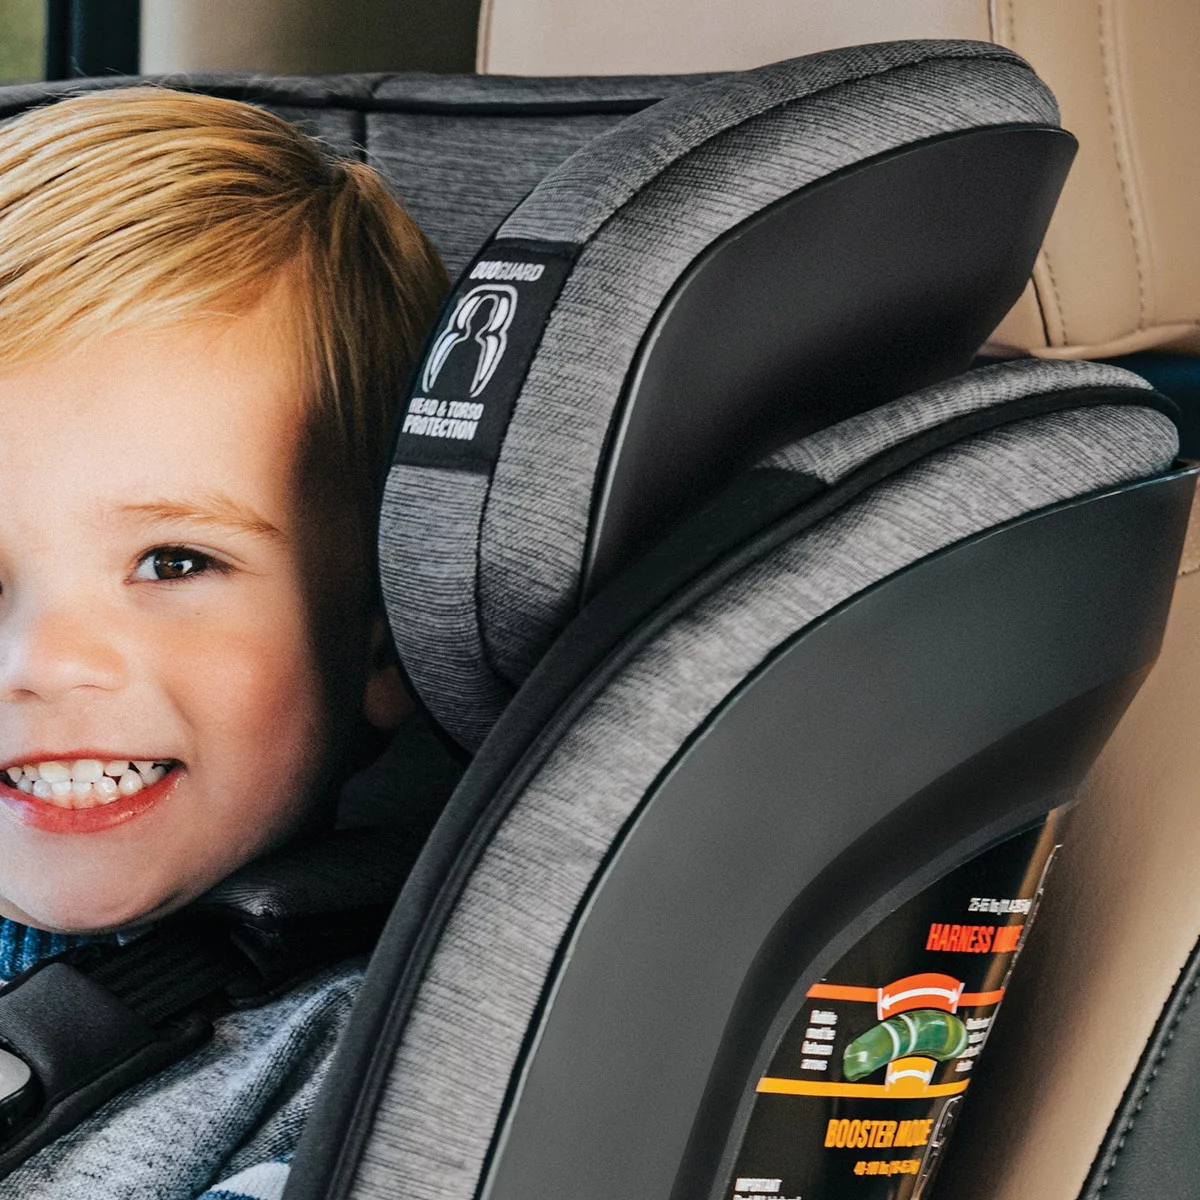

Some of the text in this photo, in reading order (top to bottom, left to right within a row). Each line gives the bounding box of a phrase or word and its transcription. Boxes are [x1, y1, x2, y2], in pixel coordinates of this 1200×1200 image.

[469, 260, 545, 282] DUOGUARD
[408, 397, 438, 415] HEAD
[448, 401, 484, 420] TORSO
[402, 414, 479, 441] PROTECTION
[925, 922, 995, 953] HARNESS
[824, 1118, 898, 1148] BOOSTER
